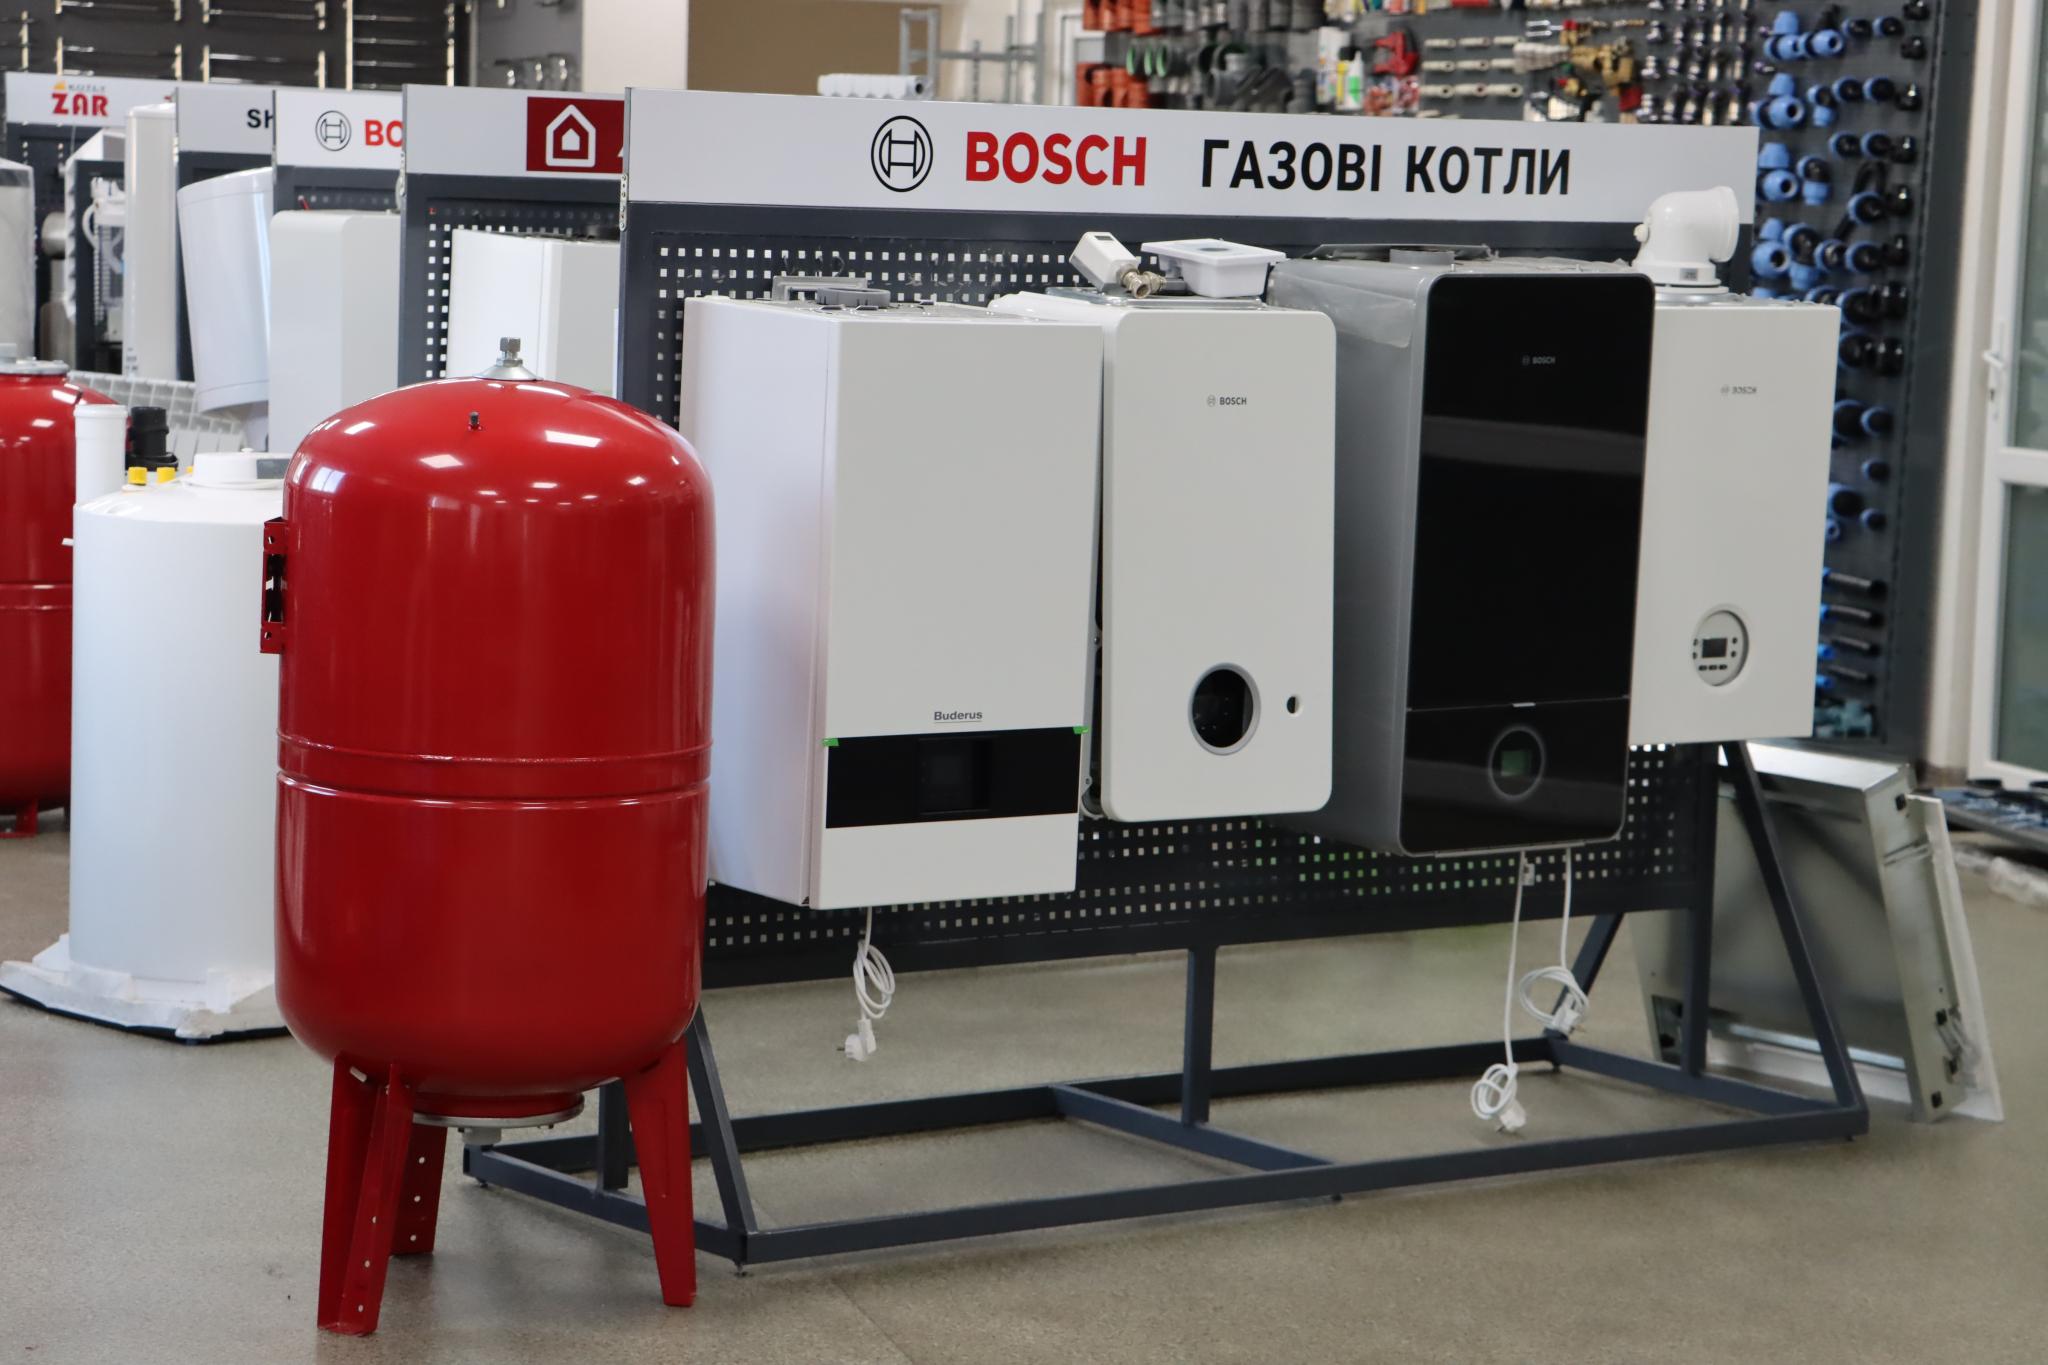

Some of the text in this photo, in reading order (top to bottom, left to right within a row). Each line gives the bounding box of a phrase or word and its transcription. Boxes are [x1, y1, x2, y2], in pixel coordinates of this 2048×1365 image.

[52, 92, 108, 117] ZAR
[965, 131, 1147, 186] BOSCH
[1201, 139, 1571, 195] ГАЗОВІ КОТЛИ
[1219, 396, 1247, 406] BOSCH
[934, 710, 983, 721] Buderus
